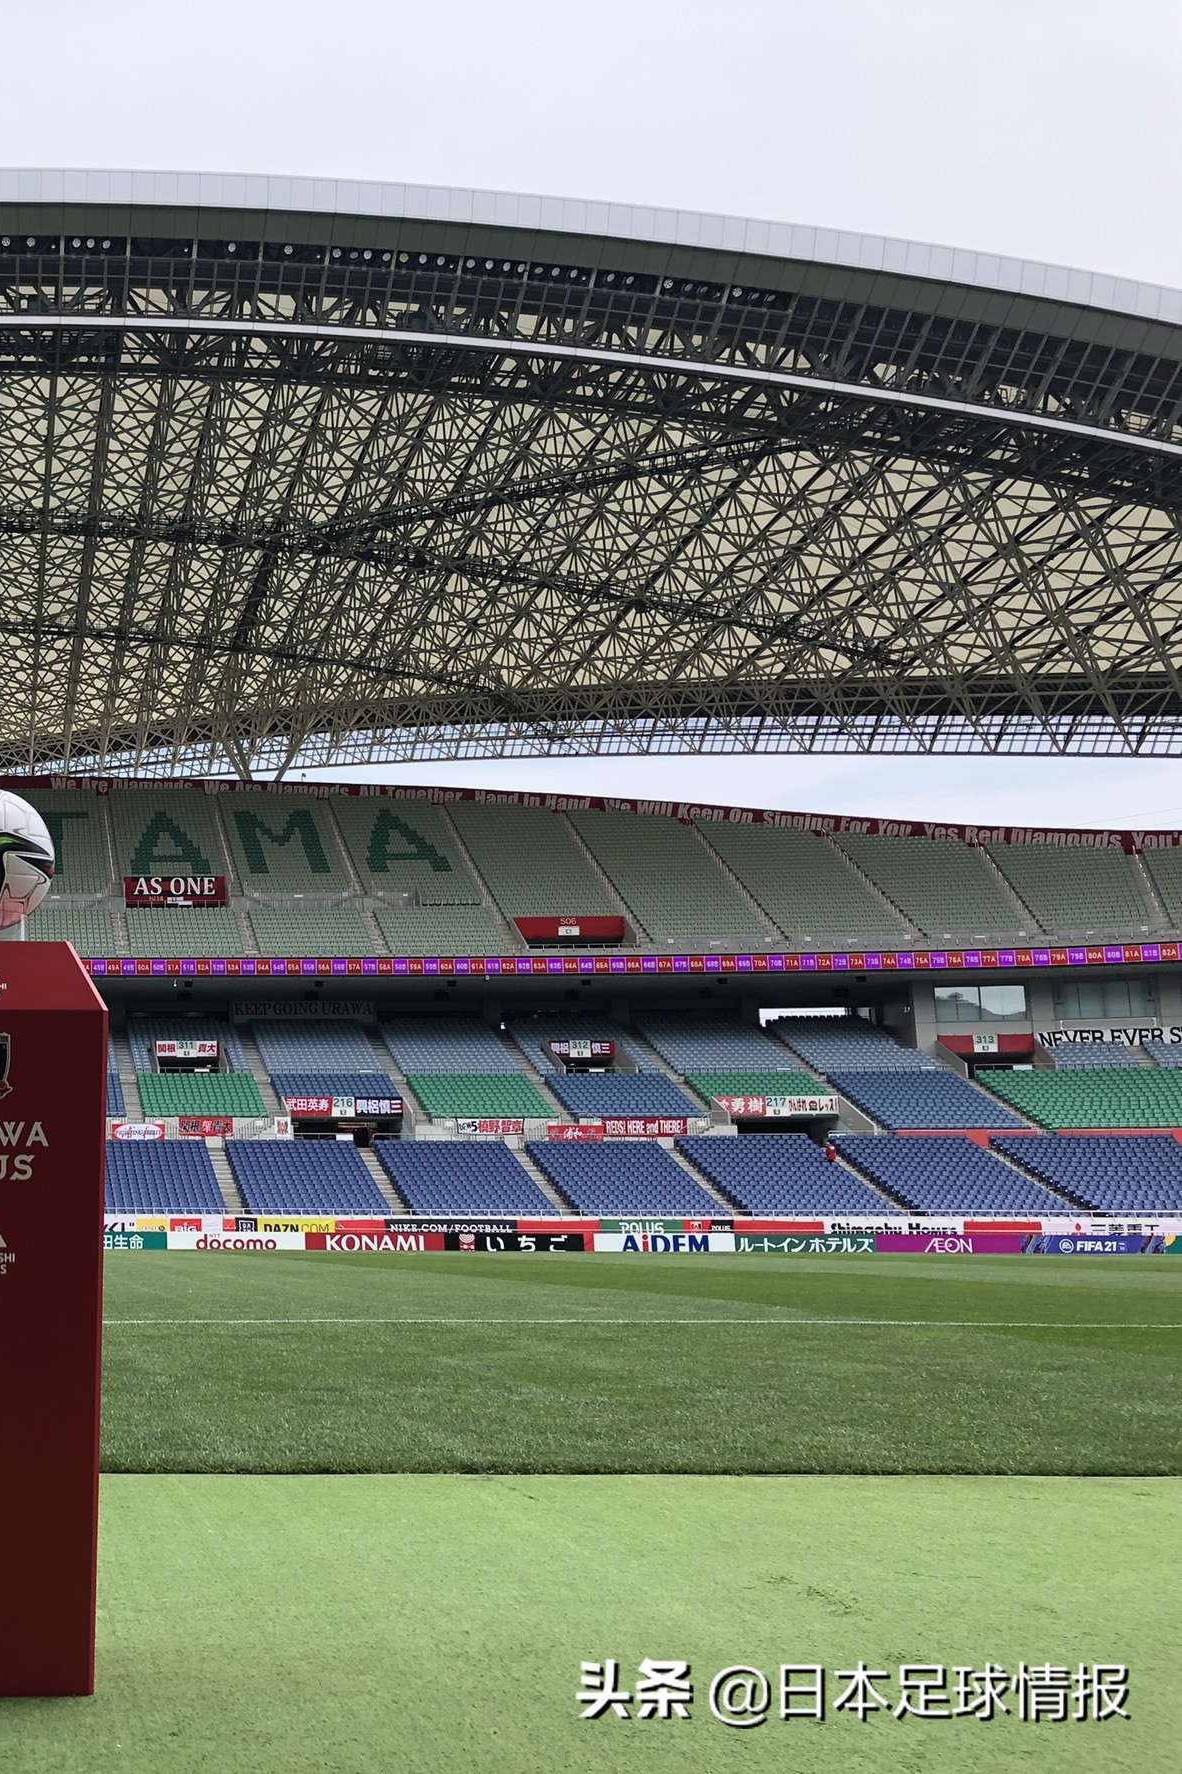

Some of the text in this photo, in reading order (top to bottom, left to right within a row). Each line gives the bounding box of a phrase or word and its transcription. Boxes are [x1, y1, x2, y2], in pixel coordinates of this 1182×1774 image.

[51, 777, 78, 790] We
[203, 780, 231, 795] We
[636, 800, 673, 816] Will
[878, 819, 912, 837] You
[924, 824, 959, 841] Yes
[964, 825, 1005, 844] Red
[1011, 828, 1121, 848] Diamonds
[134, 877, 215, 895] AS ONE
[560, 917, 576, 925] 506
[235, 1002, 372, 1015] KEEP GOING URAWA
[976, 1035, 994, 1043] 313
[179, 1041, 194, 1049] 311
[572, 1041, 588, 1049] 312
[287, 1098, 329, 1112] 武田英寿
[333, 1097, 353, 1107] 216
[766, 1097, 787, 1107] 217
[606, 1119, 684, 1134] REDS! HERE and THERE!
[196, 1234, 277, 1250] docomo
[325, 1234, 424, 1251] KONAMI
[1076, 1241, 1102, 1251] FIFA
[1104, 1241, 1117, 1251] 21
